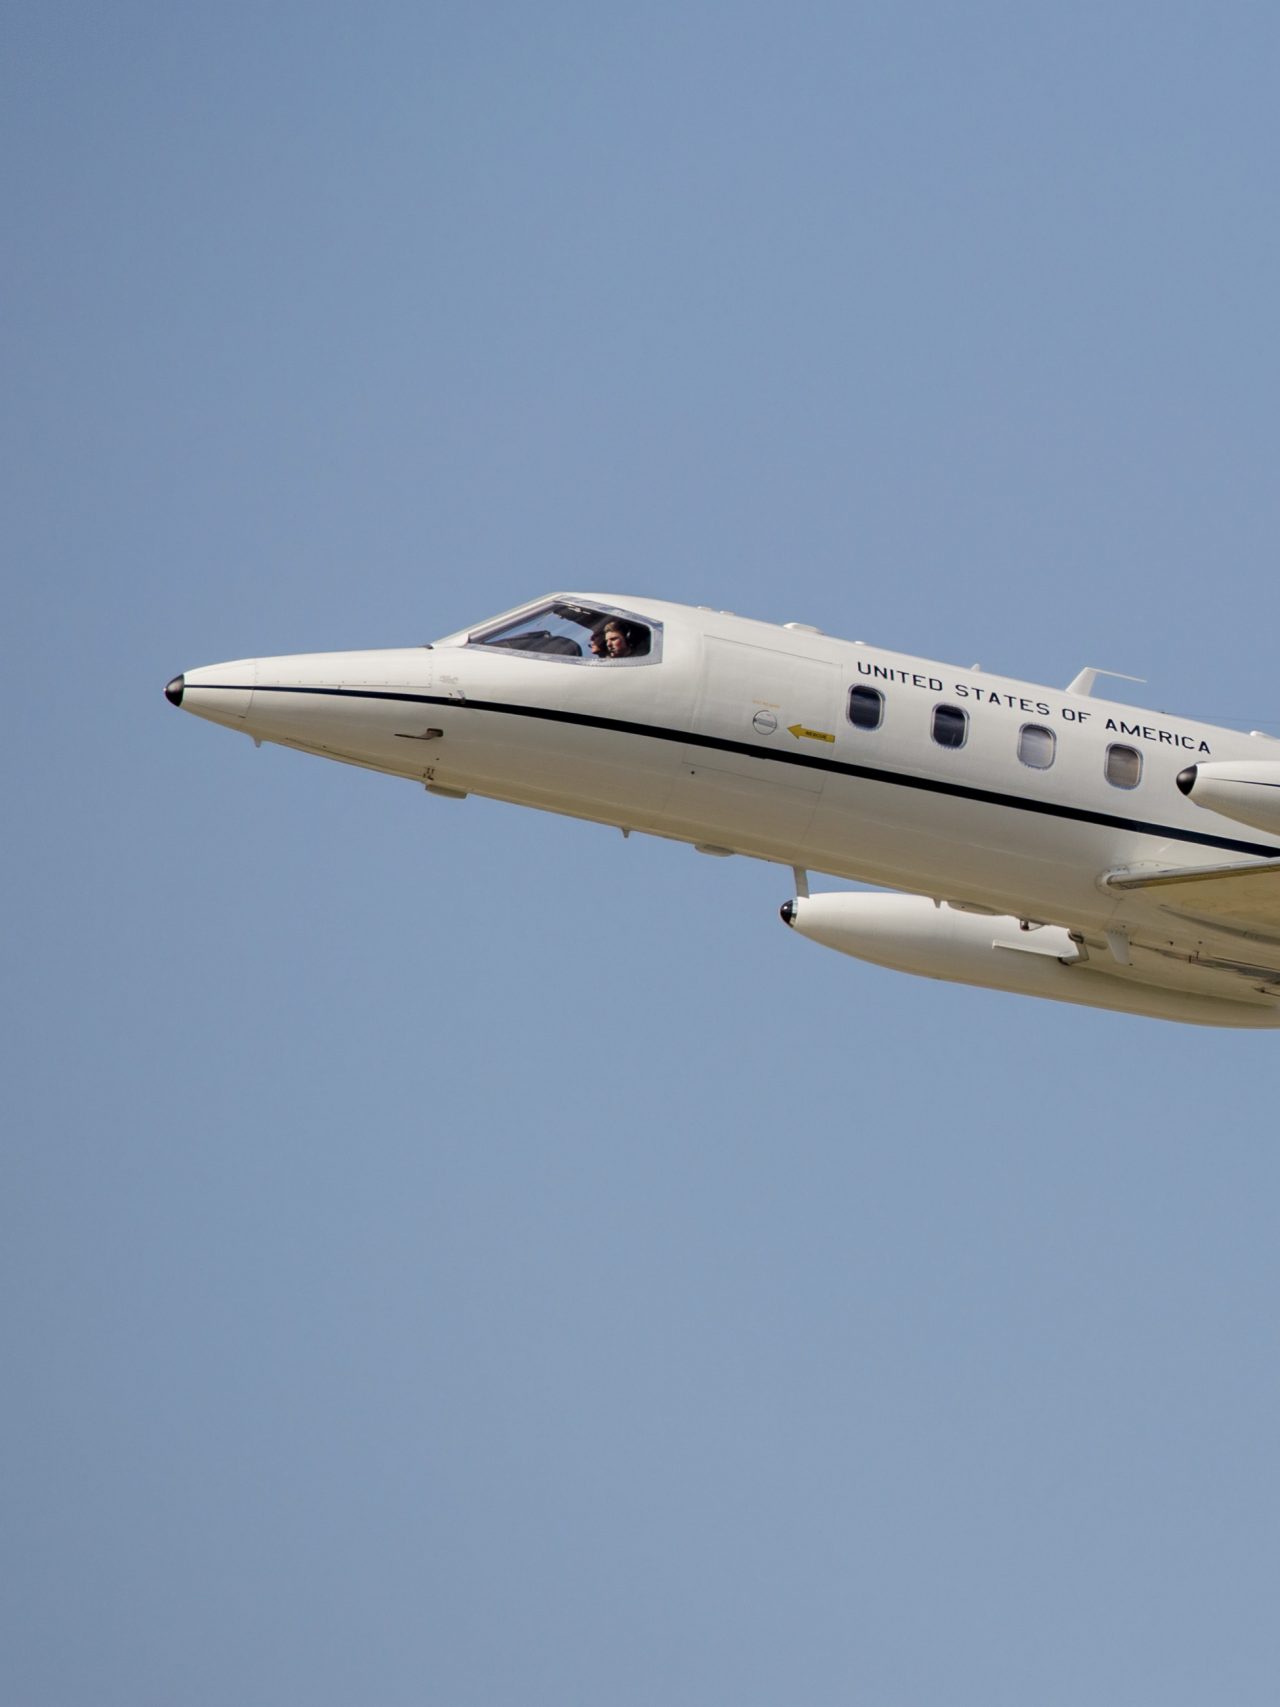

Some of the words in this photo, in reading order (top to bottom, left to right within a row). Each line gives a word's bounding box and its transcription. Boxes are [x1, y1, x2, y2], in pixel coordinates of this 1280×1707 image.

[857, 661, 943, 692] UNITED
[955, 684, 1050, 716] STATES
[1061, 708, 1091, 723] OF
[1105, 718, 1211, 755] AMERICA
